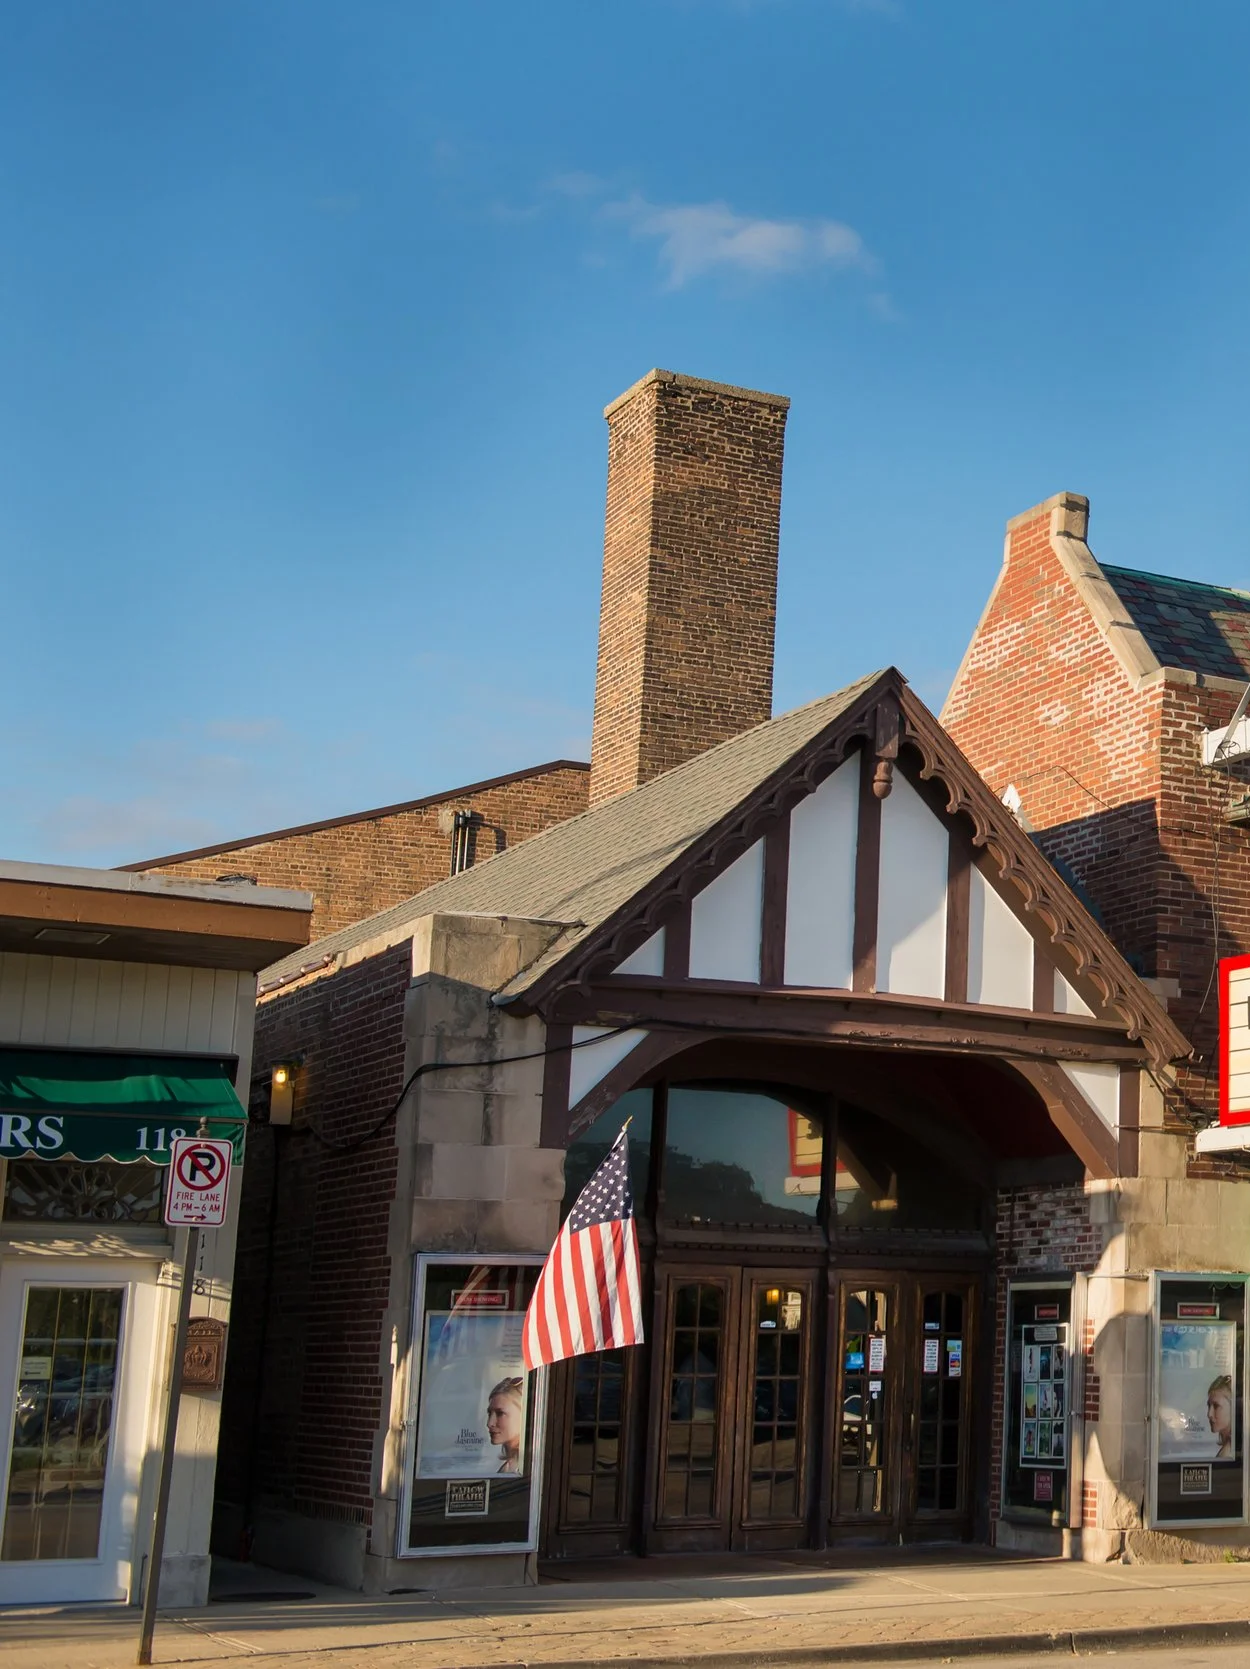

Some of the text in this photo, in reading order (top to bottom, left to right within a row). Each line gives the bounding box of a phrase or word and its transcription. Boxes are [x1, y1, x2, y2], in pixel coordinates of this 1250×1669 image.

[176, 1191, 220, 1202] FIRE LANE
[173, 1202, 179, 1210] 4
[181, 1202, 193, 1211] PM
[201, 1203, 207, 1212] 6
[209, 1204, 220, 1213] AM
[460, 1428, 477, 1438] Blue
[455, 1434, 485, 1445] Jasmine
